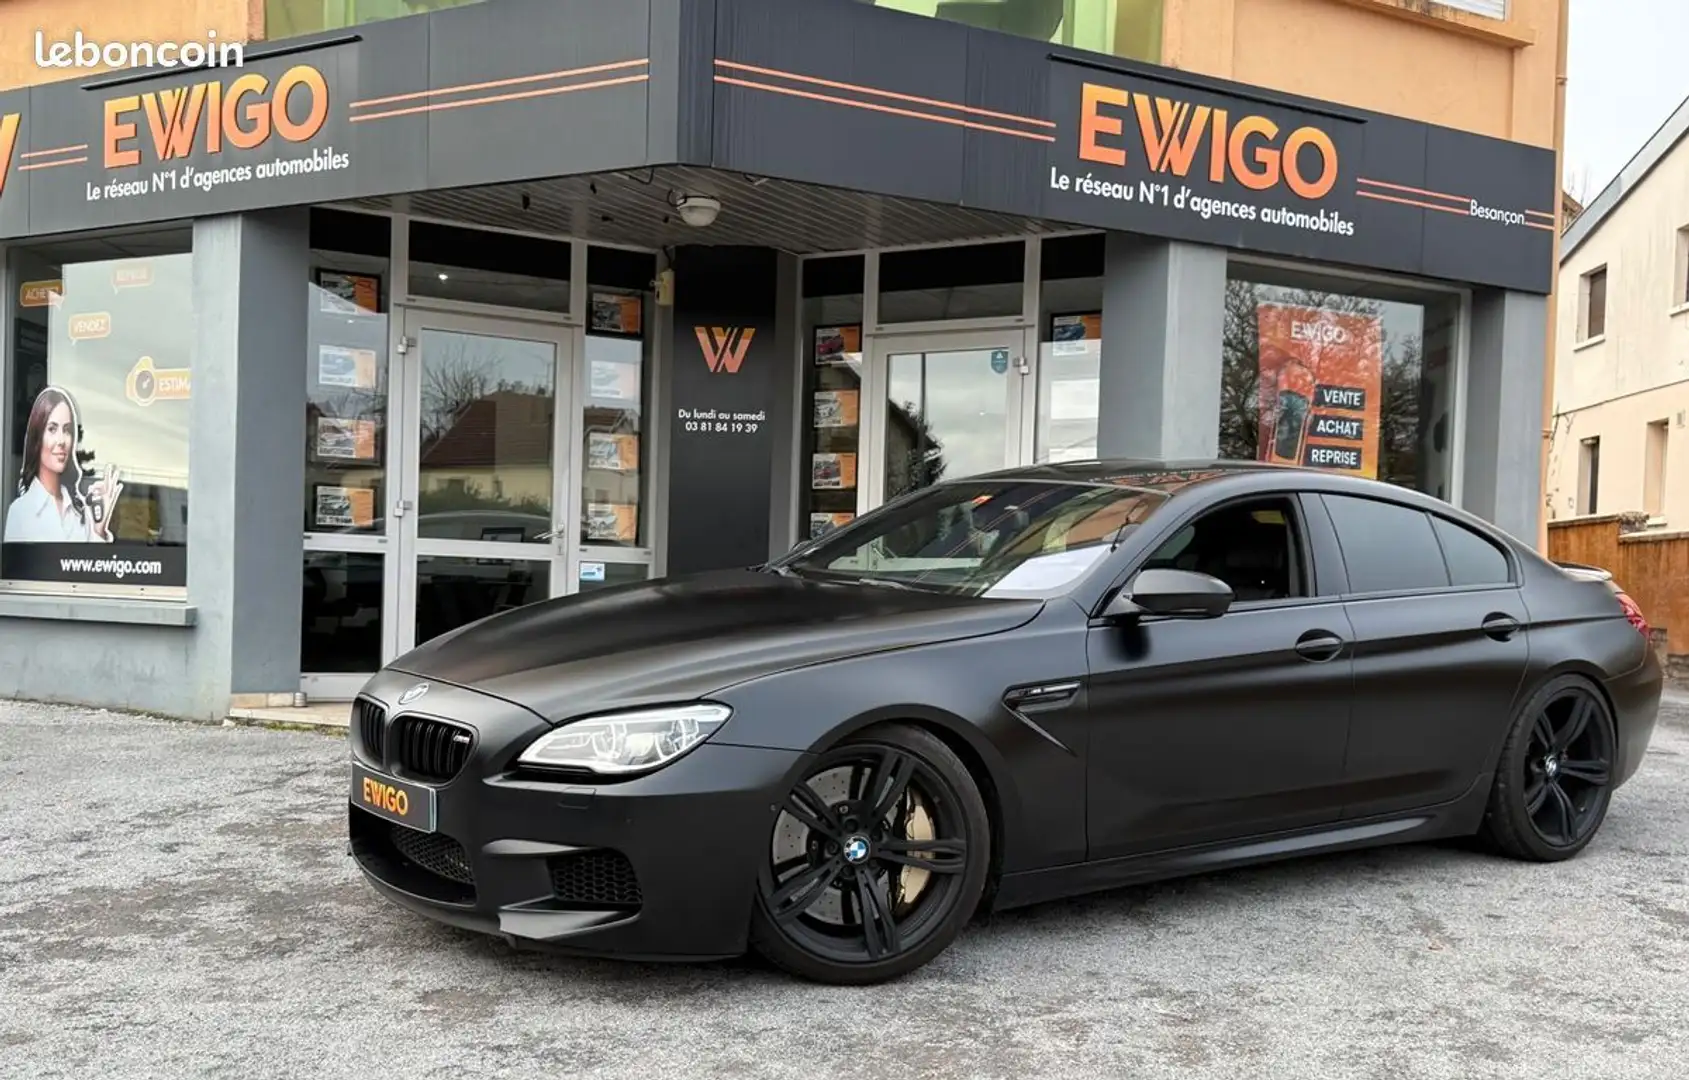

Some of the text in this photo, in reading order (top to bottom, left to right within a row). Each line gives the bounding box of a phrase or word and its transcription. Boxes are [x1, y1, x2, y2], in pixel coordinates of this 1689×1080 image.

[103, 65, 329, 169] EWIGO
[1078, 82, 1338, 199] EWIGO
[86, 181, 101, 201] Le
[104, 178, 149, 198] réseau
[255, 147, 349, 178] automobiles
[1050, 167, 1070, 191] Le
[1075, 174, 1134, 201] réseau
[1261, 207, 1354, 236] automobiles
[1470, 199, 1525, 226] Besançon
[1291, 320, 1347, 343] EWIGO
[1324, 389, 1362, 406] VENTE
[678, 408, 766, 421] Du lundi au samedi
[685, 421, 758, 433] 03 81 84 19 39
[1316, 420, 1360, 435] ACHAT
[1311, 449, 1357, 465] REPRISE
[60, 554, 162, 578] www.ewigo.com
[363, 777, 409, 815] EWIGO
